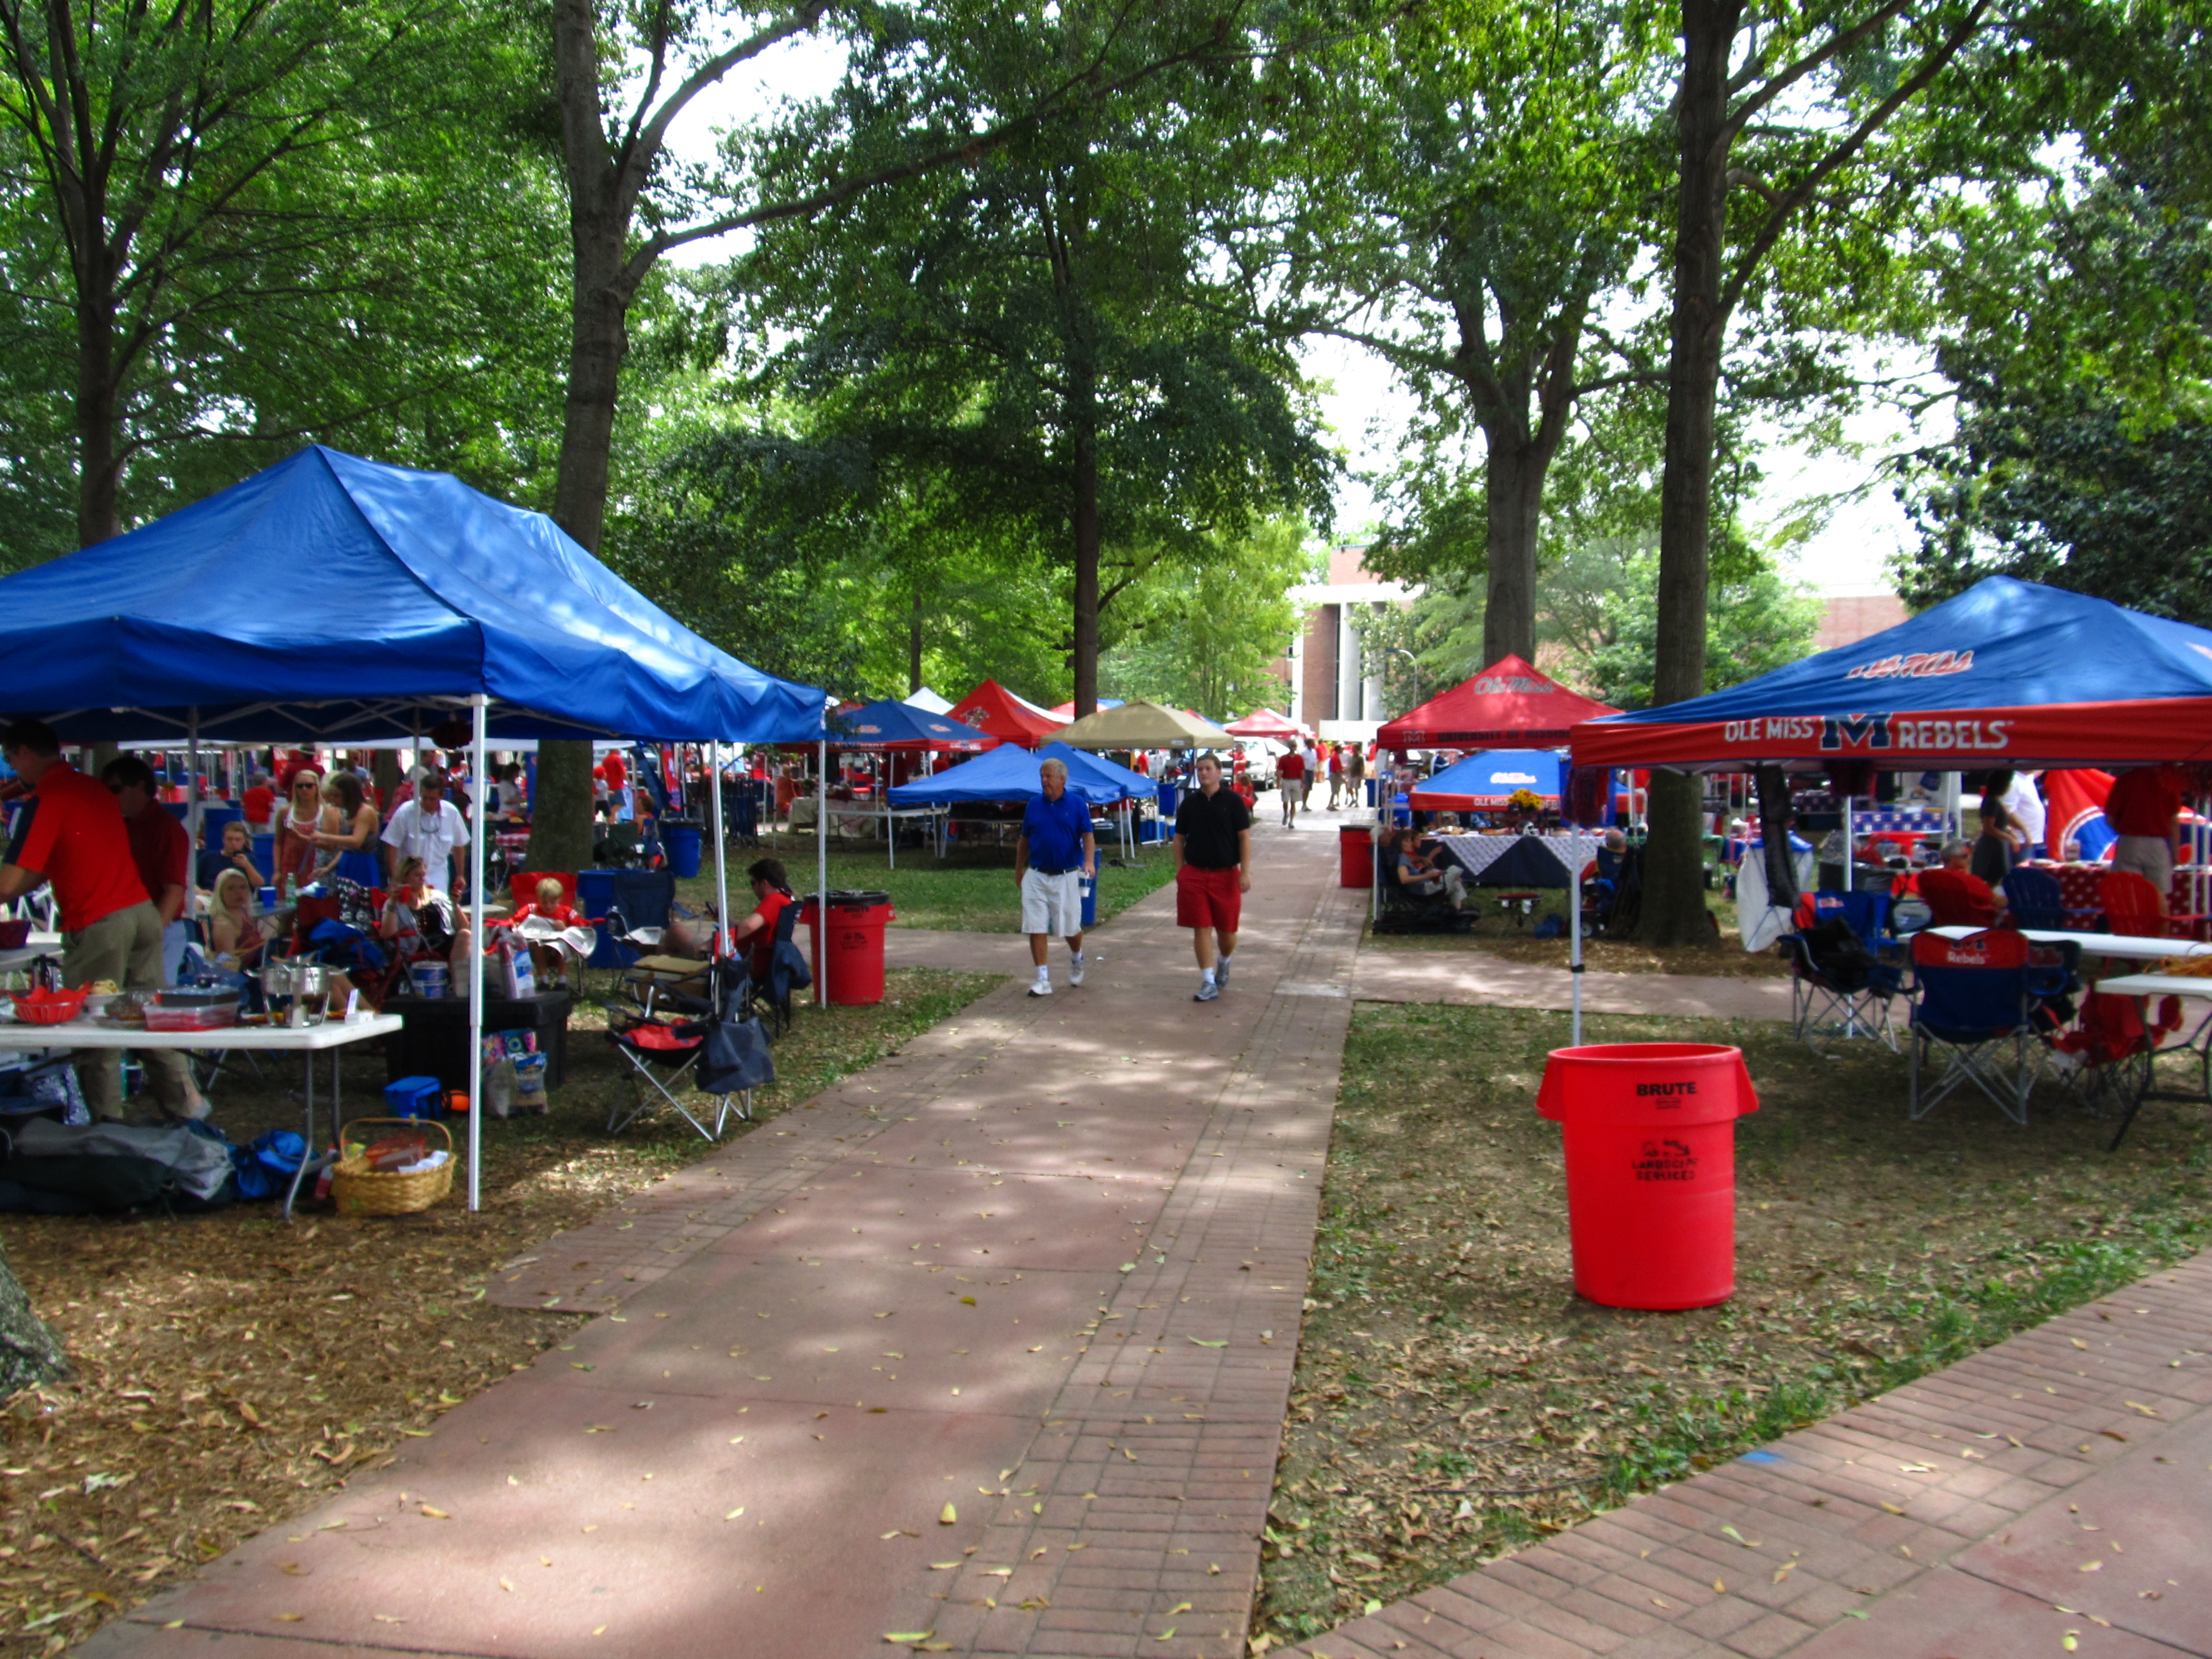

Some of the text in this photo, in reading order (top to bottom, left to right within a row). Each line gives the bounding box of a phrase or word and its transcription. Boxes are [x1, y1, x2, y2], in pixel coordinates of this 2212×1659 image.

[1474, 676, 1555, 695] Ole Miss
[1724, 712, 2009, 750] OLE MISS M REBELS
[1947, 951, 1986, 965] Rebels
[1636, 1082, 1697, 1097] BRUTE
